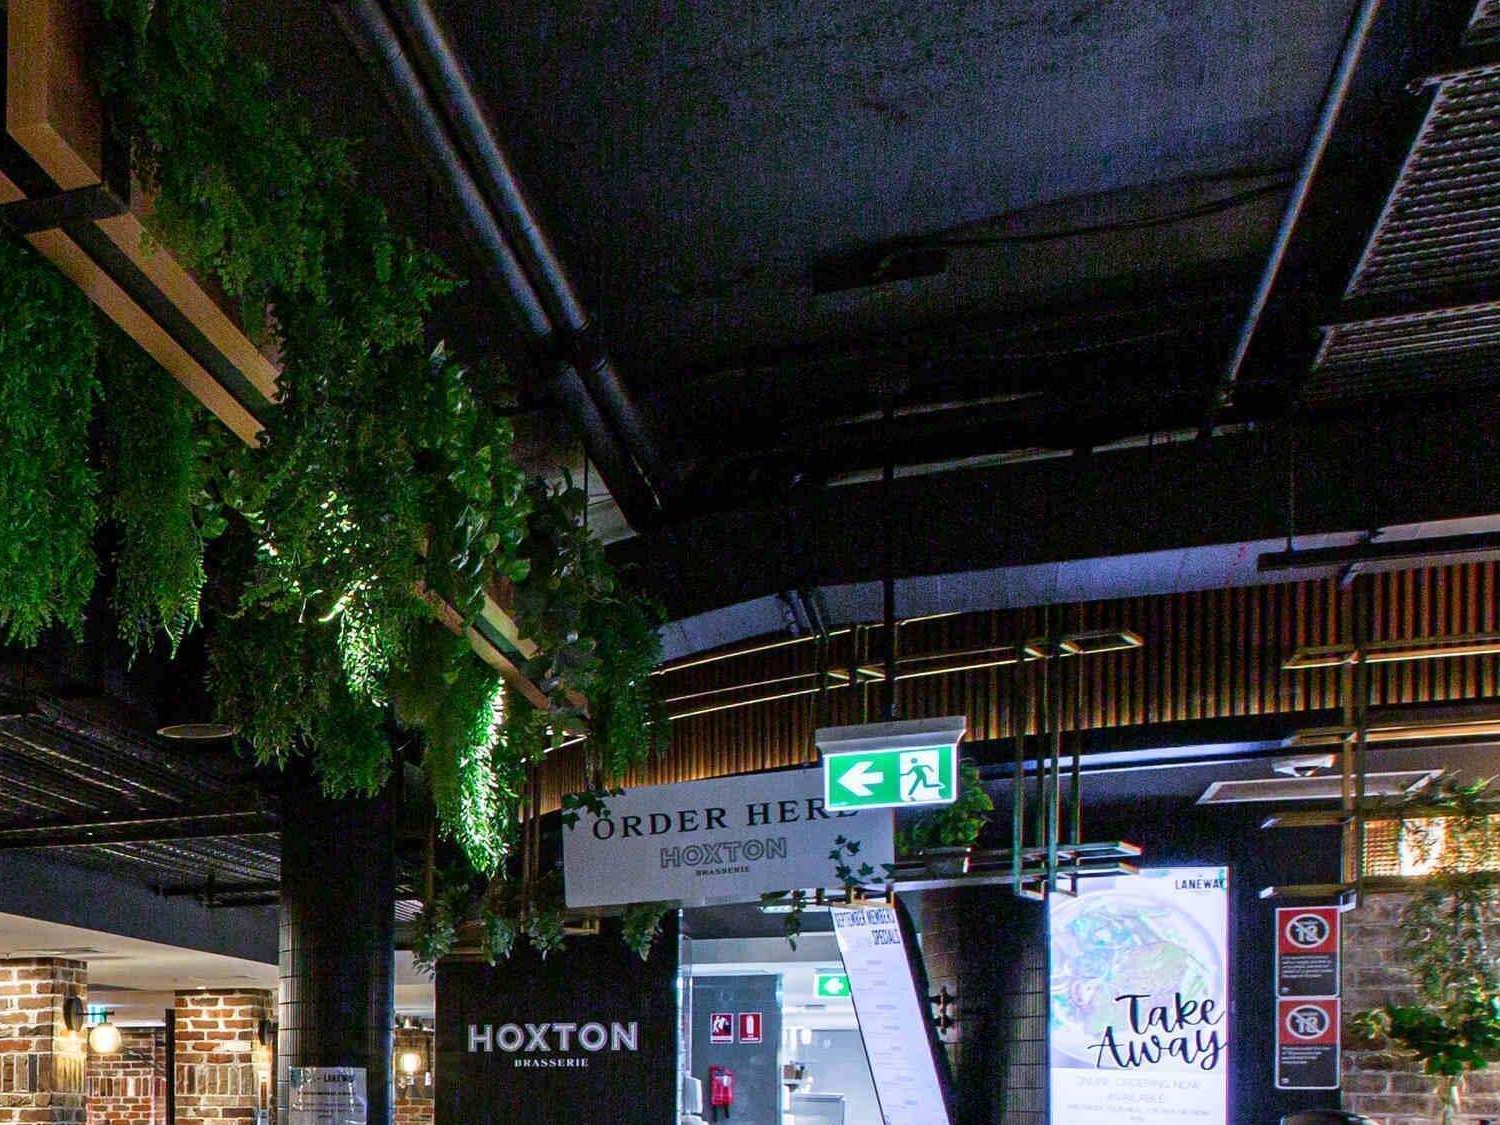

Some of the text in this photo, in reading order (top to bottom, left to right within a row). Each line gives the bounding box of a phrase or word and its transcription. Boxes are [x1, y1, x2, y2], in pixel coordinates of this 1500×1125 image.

[592, 807, 728, 840] ORDER
[659, 836, 788, 869] HOXTON
[695, 865, 750, 876] BRASSERIE
[1115, 992, 1226, 1035] Take
[467, 1022, 638, 1052] HOXTON
[1087, 1026, 1229, 1071] Away
[514, 1057, 589, 1068] BRASSERIE
